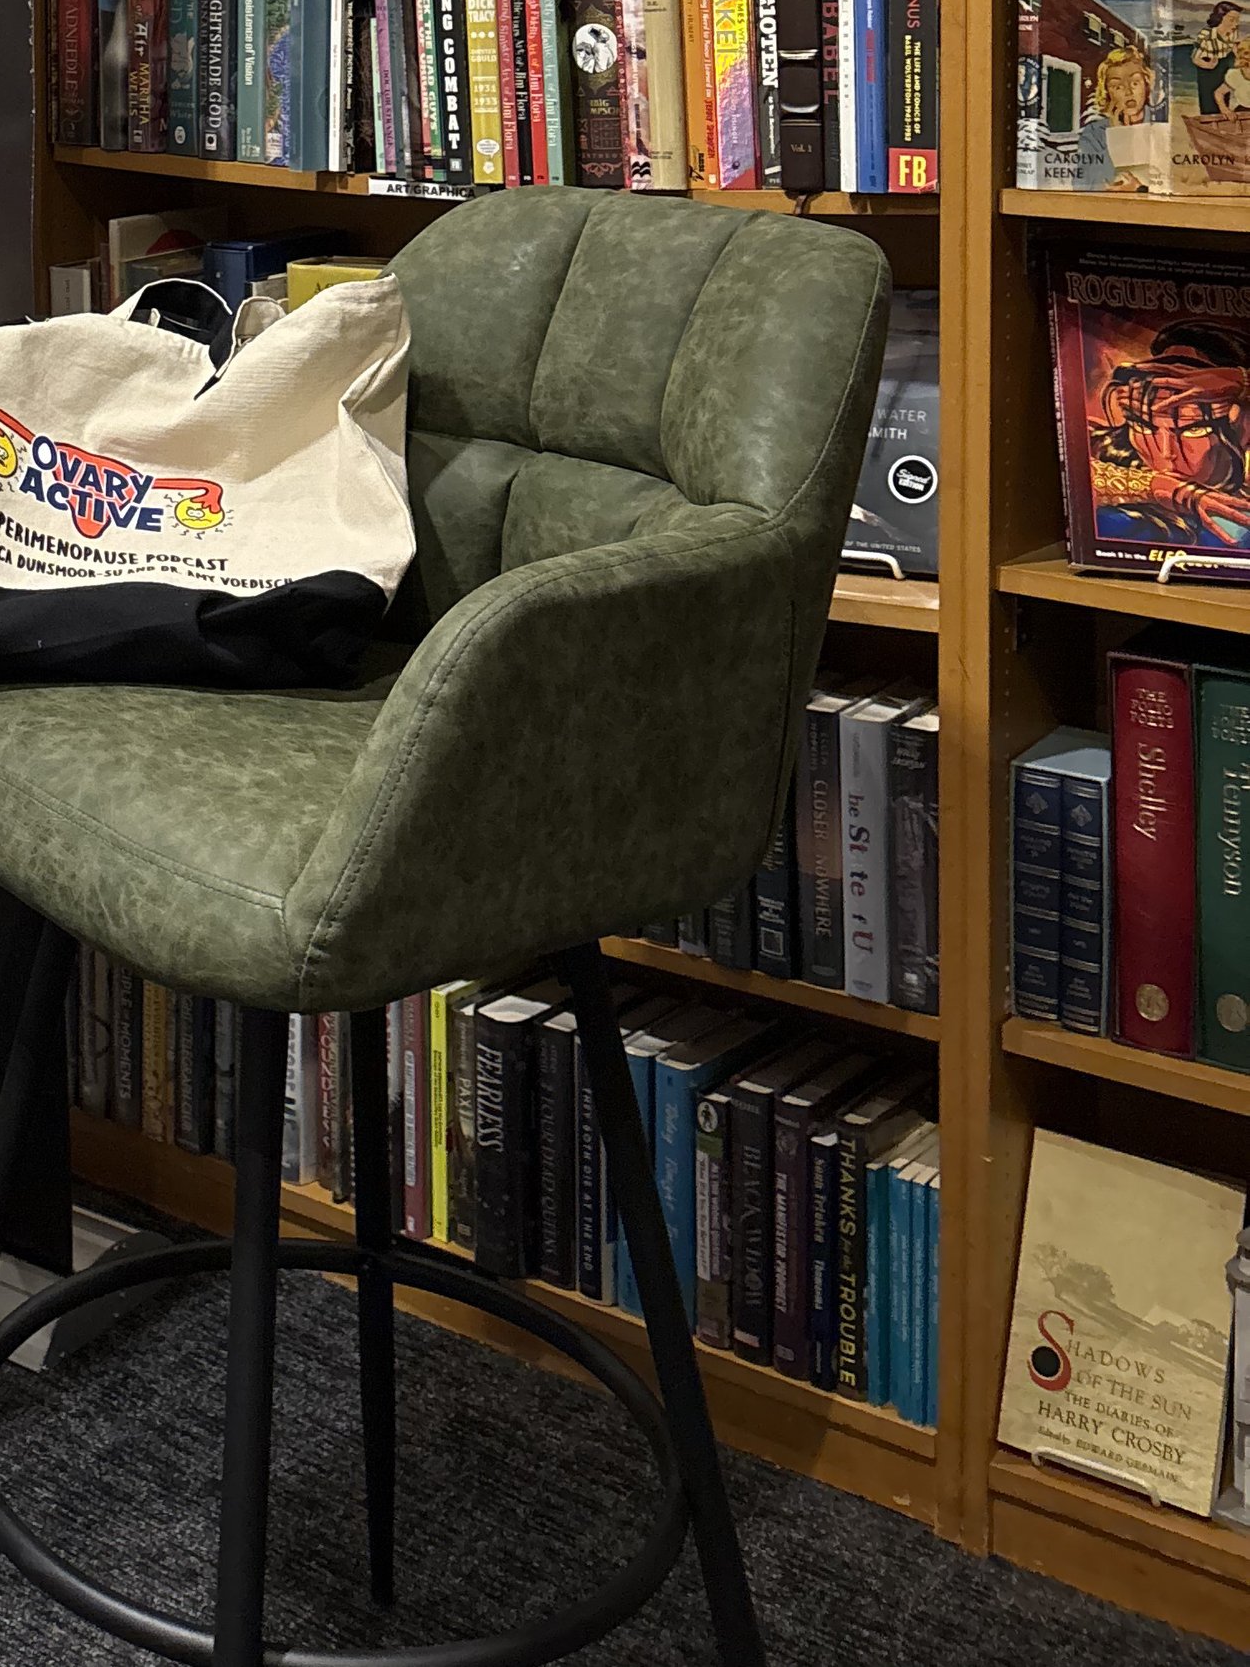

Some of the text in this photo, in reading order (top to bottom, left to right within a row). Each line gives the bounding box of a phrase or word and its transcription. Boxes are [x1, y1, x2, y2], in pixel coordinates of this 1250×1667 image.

[822, 1, 839, 105] BABEL
[129, 71, 139, 116] WELLS
[138, 62, 150, 125] MARTHA
[443, 38, 460, 151] COMBAT
[898, 156, 927, 186] FB
[1044, 153, 1105, 165] CAROLYN
[1044, 167, 1084, 179] KEENE
[1172, 154, 1235, 166] CAROLYN
[876, 408, 928, 423] WATER
[20, 466, 164, 533] ACTIVE
[32, 435, 156, 505] OVARY
[17, 556, 123, 579] DUNSMOOR-SU
[187, 571, 215, 584] AMY
[146, 554, 228, 571] PODCAST
[1132, 742, 1167, 842] Shelley
[813, 780, 831, 937] CLOSER NOWHERE
[476, 1042, 503, 1152] FEARLESS
[840, 1139, 856, 1387] THANKS TROUBLE
[1026, 1309, 1166, 1392] SHADOWS
[1064, 1390, 1175, 1439] THE DIARIES OF
[1075, 1369, 1192, 1422] OF THE SUN
[1037, 1399, 1185, 1466] HARRY CROSBY
